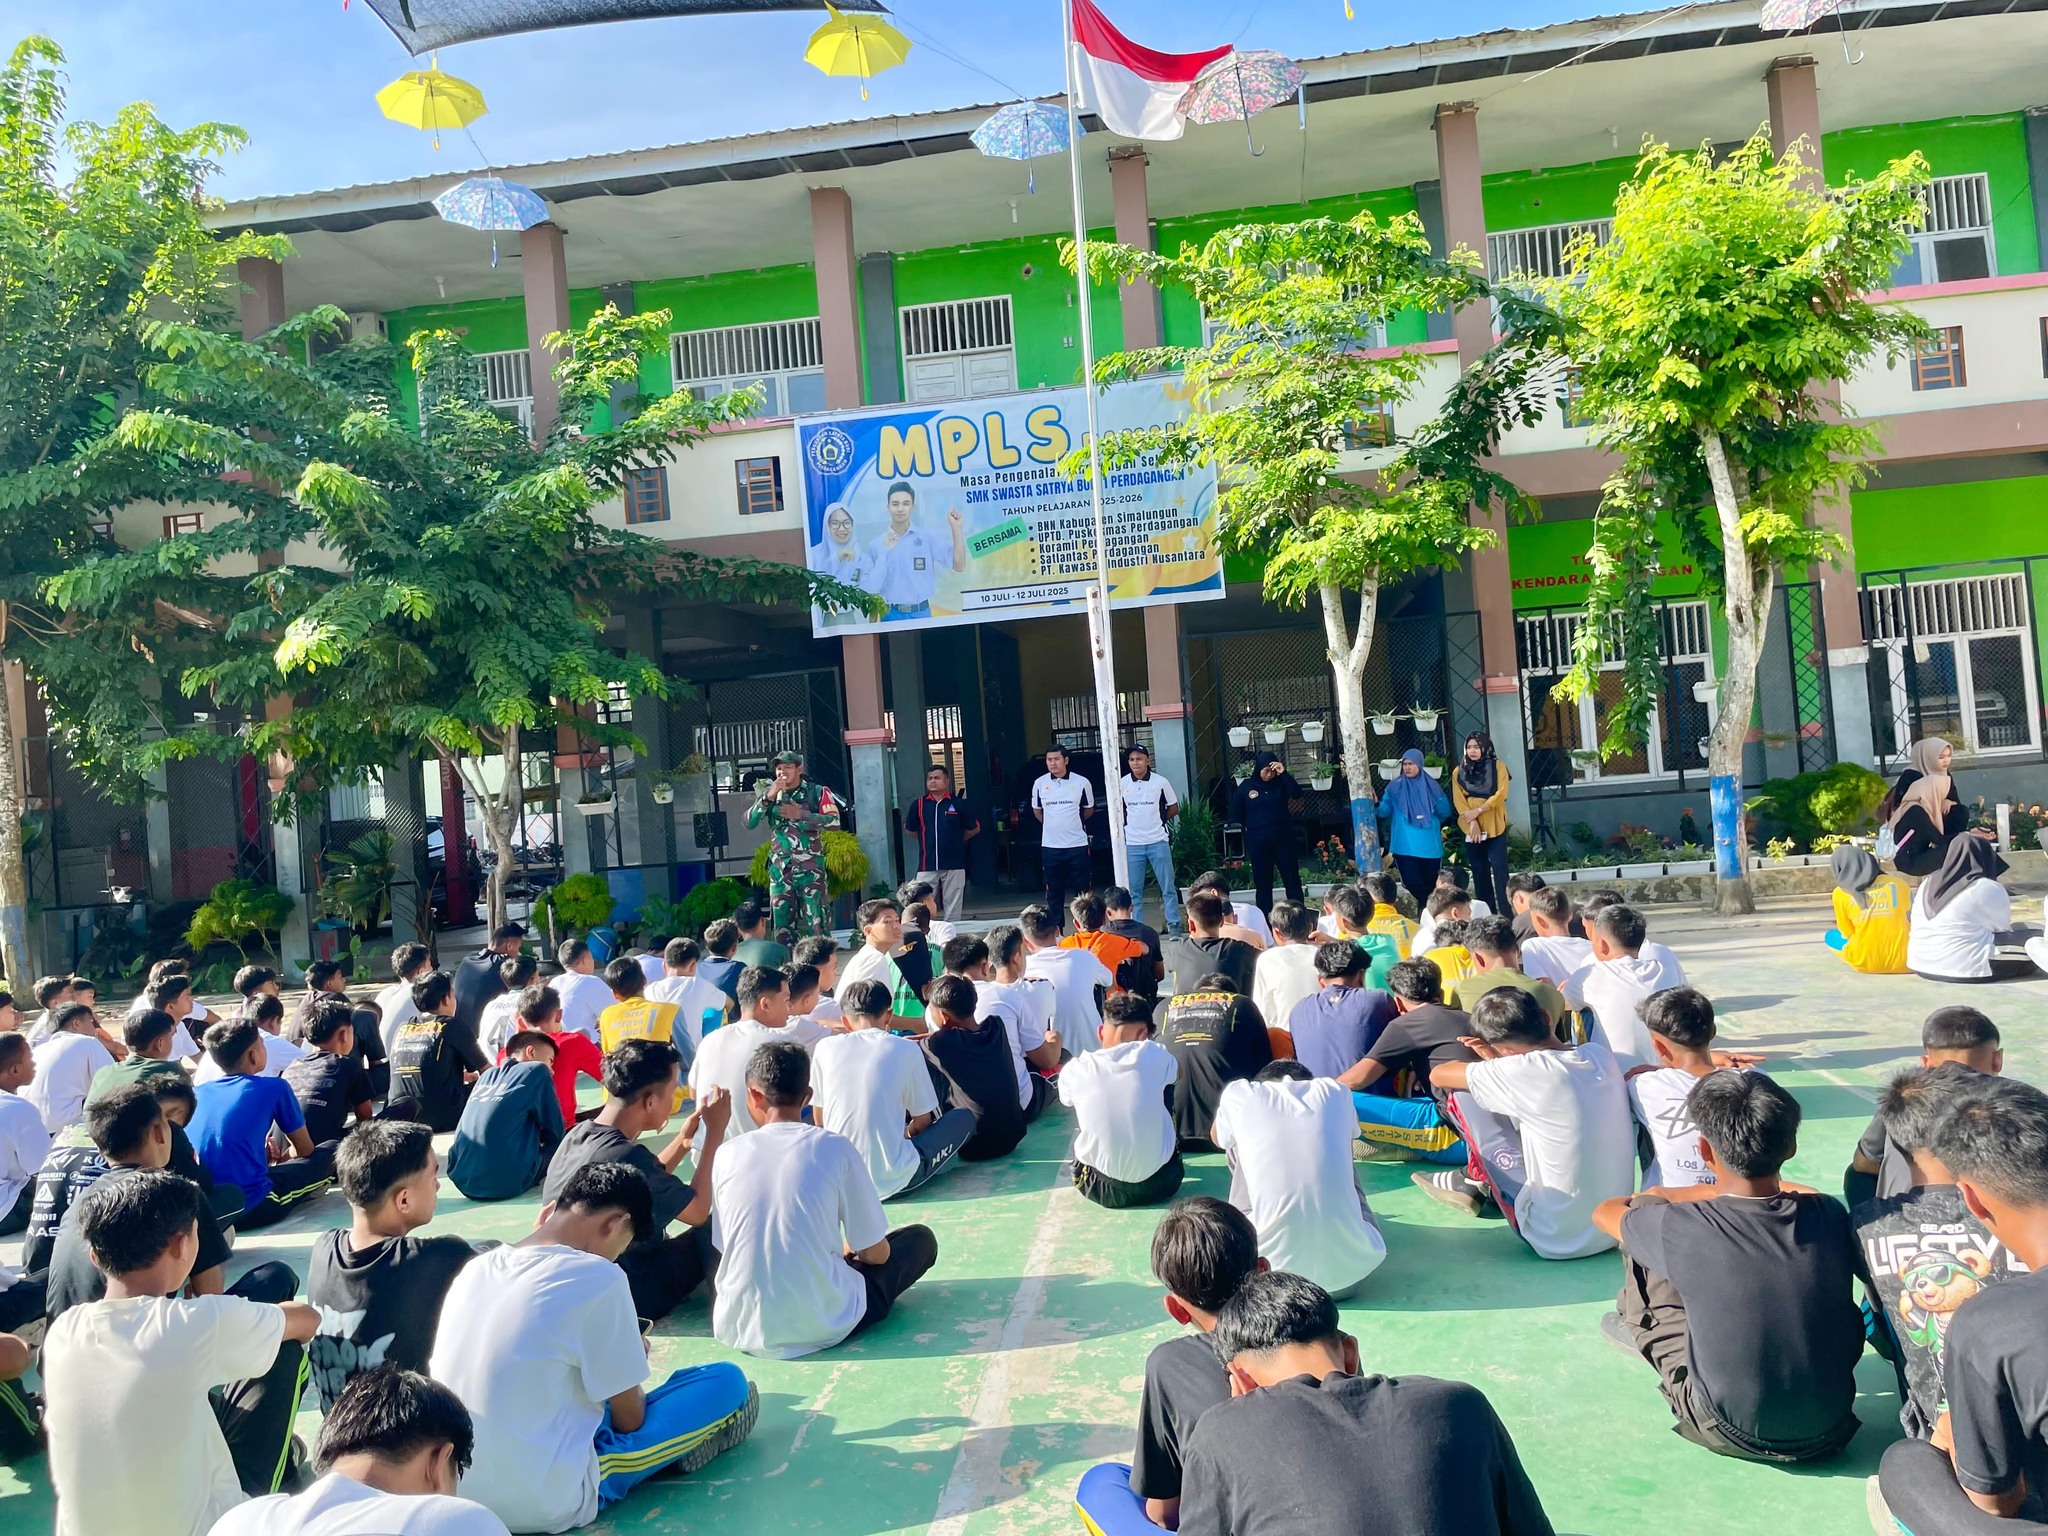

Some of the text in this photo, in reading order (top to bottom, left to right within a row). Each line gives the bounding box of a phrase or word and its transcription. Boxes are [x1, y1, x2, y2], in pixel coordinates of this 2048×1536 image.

[876, 405, 1071, 480] MPLS
[960, 474, 991, 488] Masa
[966, 488, 990, 504] SMK
[992, 484, 1033, 501] SWASTA
[1036, 479, 1074, 496] SATRYA
[1111, 468, 1185, 488] PERDAGANGAN
[1002, 493, 1143, 516] TAHUN PELAJARAN 025-2026
[1037, 507, 1178, 532] BNN Kabupaen Simalungun
[1038, 517, 1199, 543] UPTD. Puskemas Perdagangan
[973, 525, 1022, 552] BERSAMA
[1039, 533, 1149, 554] Koramil Peragangan
[1040, 543, 1160, 565] Satlantas Prdagangan
[1041, 550, 1205, 576] PT. Kawasa Industri Nusantara
[1511, 572, 1606, 590] KENDARA
[992, 593, 1010, 602] JULI
[1016, 591, 1026, 599] 12
[1027, 589, 1046, 599] JULI
[1047, 587, 1069, 596] 2025
[1676, 1159, 1698, 1170] LOS
[1919, 1223, 1966, 1234] BEARD
